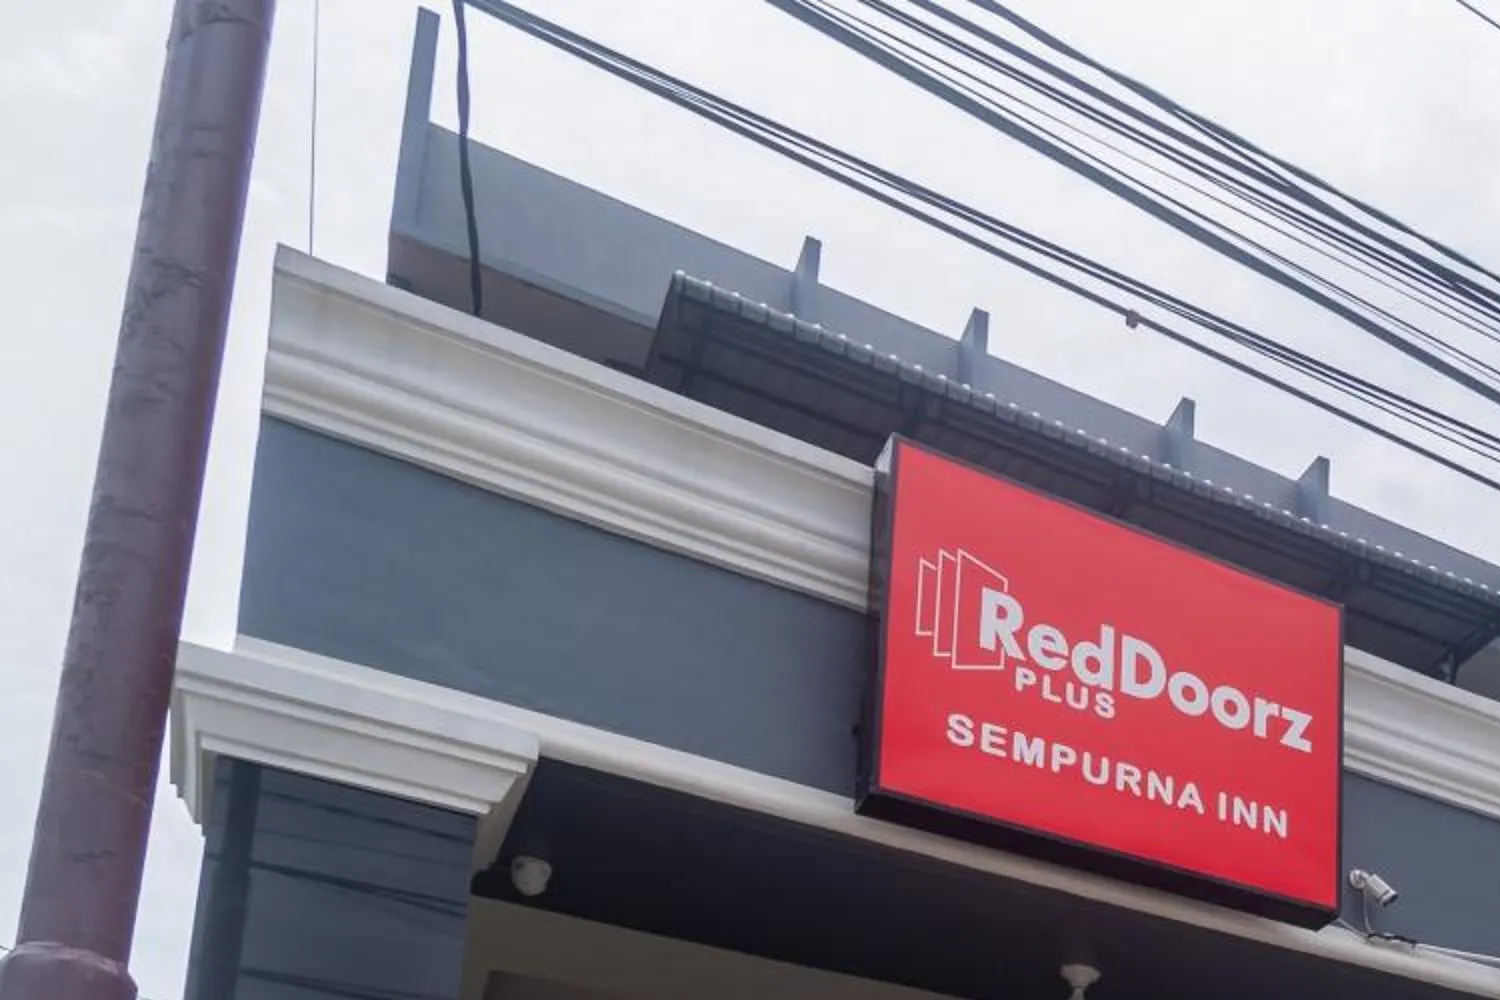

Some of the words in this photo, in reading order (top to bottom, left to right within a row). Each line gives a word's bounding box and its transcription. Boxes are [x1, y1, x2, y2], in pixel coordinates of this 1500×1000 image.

[978, 586, 1314, 753] RedDoorz
[1014, 666, 1116, 719] PLUS
[945, 713, 1205, 814] SEMPURNA
[1217, 791, 1289, 838] INN
